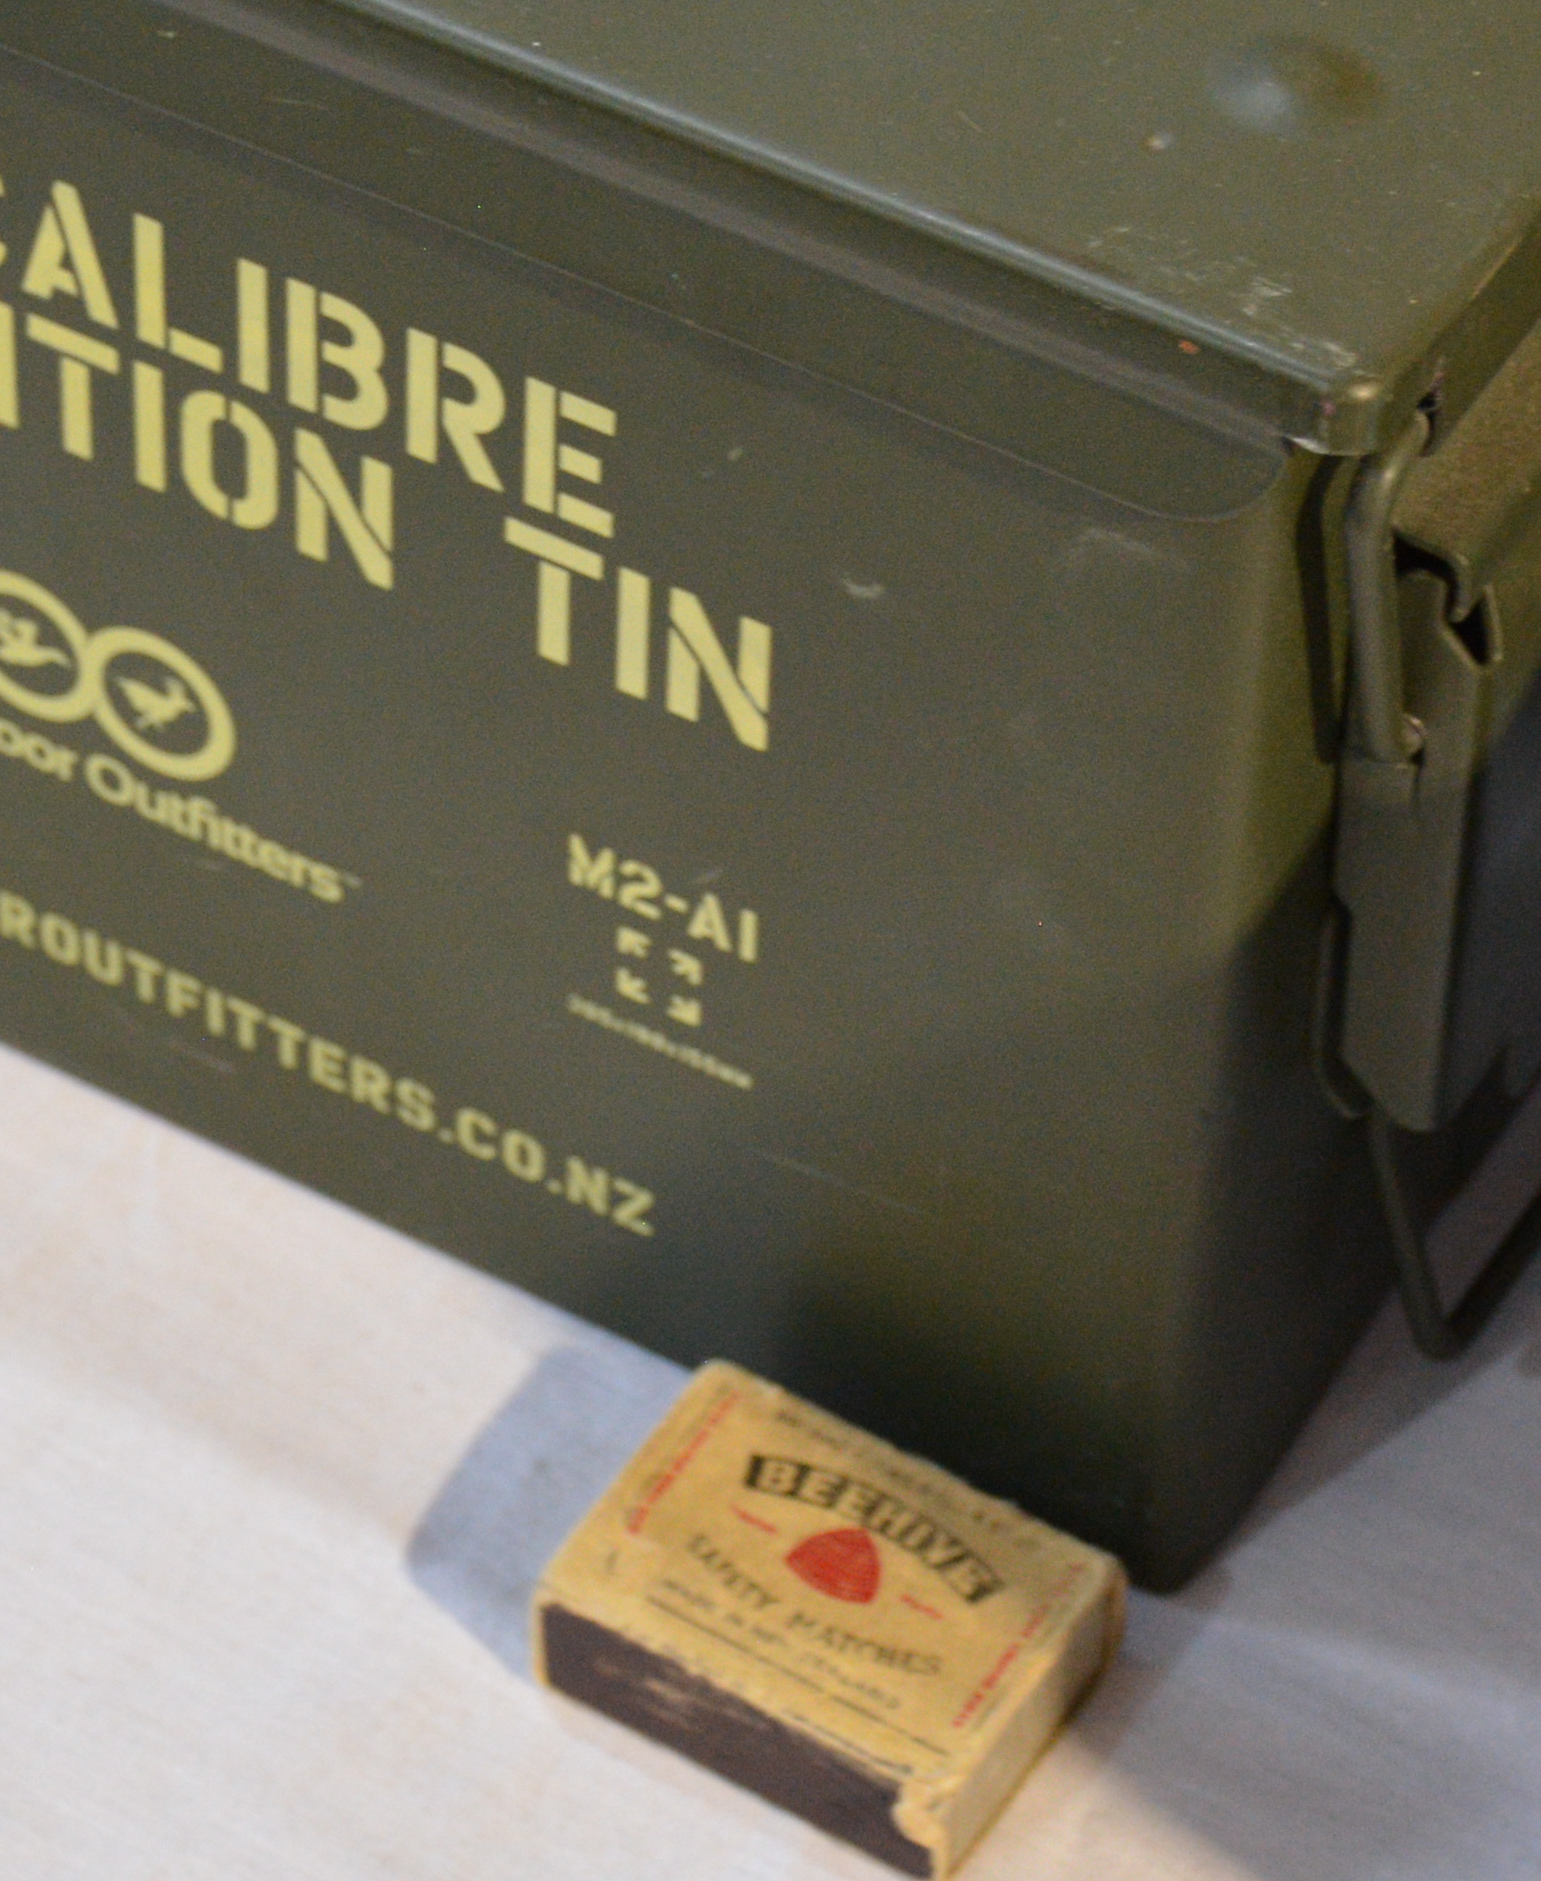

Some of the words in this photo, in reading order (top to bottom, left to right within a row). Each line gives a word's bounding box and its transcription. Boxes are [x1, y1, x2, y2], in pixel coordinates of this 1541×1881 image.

[504, 517, 771, 753] TIN
[85, 755, 346, 904] Outfitters
[747, 1455, 1000, 1604] BEEHIVE
